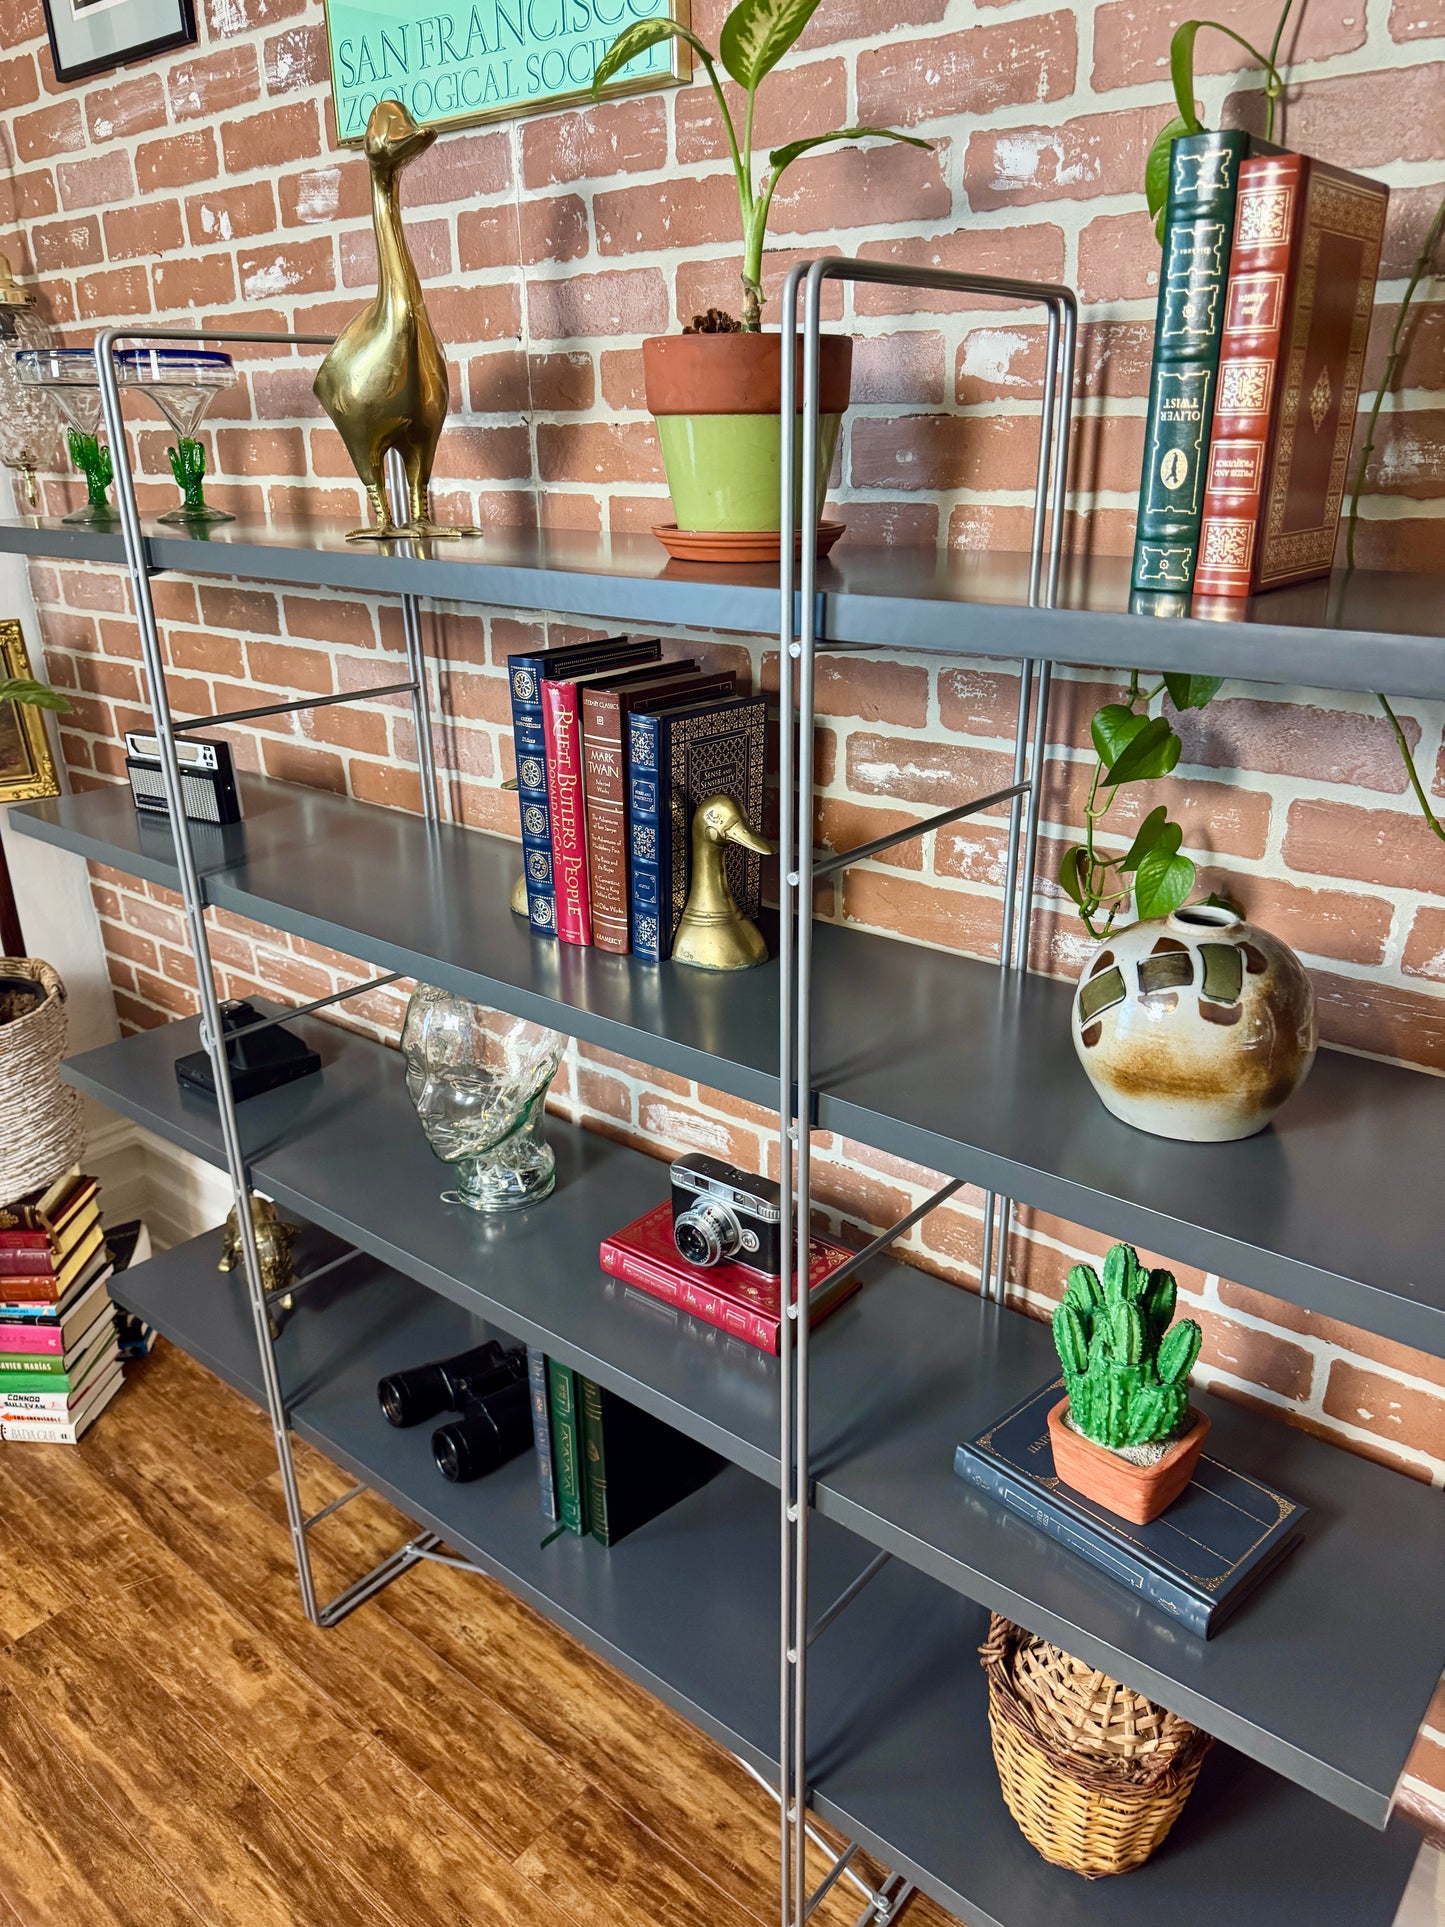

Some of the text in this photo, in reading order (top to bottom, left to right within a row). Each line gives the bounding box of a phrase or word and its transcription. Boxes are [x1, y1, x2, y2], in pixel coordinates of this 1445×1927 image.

[339, 24, 410, 89] SAN
[526, 33, 658, 93] SOCI
[1163, 397, 1199, 409] TWIST
[1160, 410, 1201, 422] OLIVER
[1215, 459, 1255, 469] PREJUDICE
[1214, 469, 1254, 478] PRIDE AND
[552, 704, 574, 769] RHETT
[591, 750, 615, 764] MARK
[588, 761, 619, 779] TWAIN
[704, 769, 722, 780] SENSE
[548, 758, 558, 811] DONALD
[700, 773, 736, 790] SENSIBILITY
[557, 772, 578, 850] BUTLER'S
[562, 854, 582, 917] PEOPLE
[0, 1361, 22, 1370] AVIER
